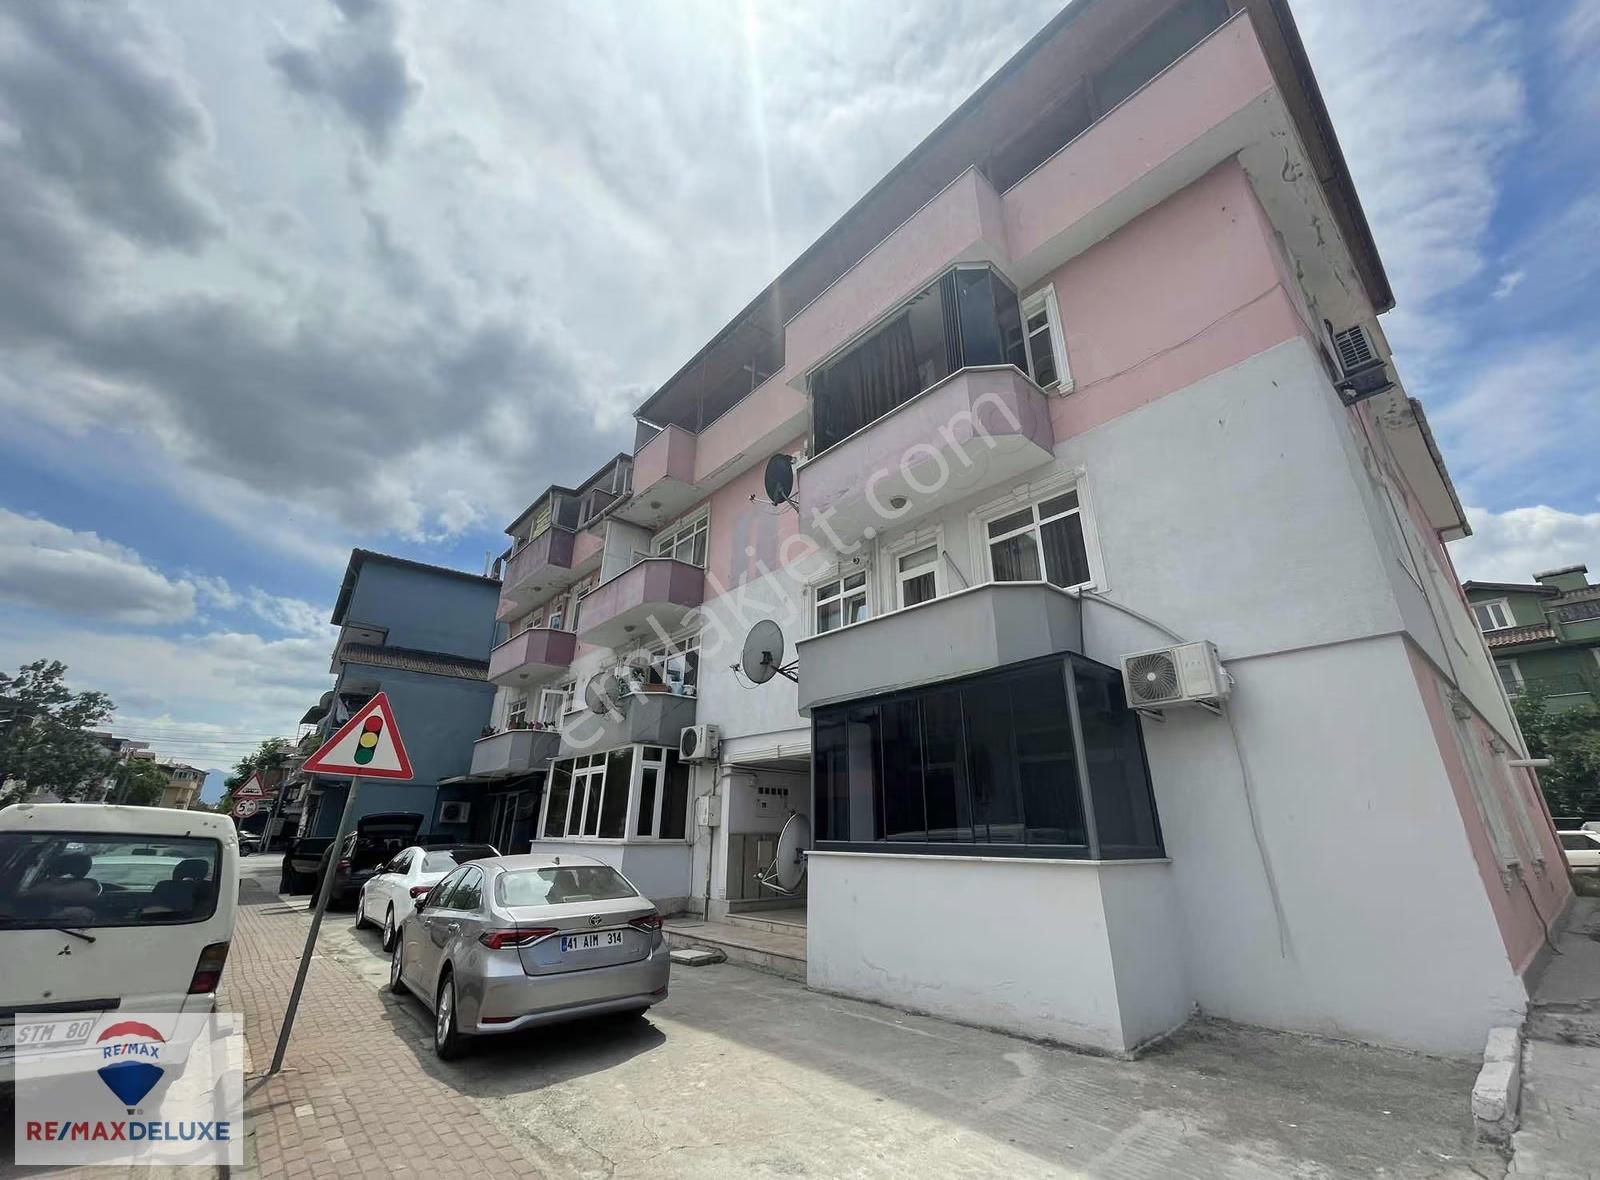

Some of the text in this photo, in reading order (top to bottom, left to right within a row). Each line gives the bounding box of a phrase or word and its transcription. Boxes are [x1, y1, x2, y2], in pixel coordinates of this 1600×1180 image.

[567, 932, 622, 949] 41 AIM 314
[17, 1024, 56, 1043] STM
[66, 1022, 90, 1039] 80
